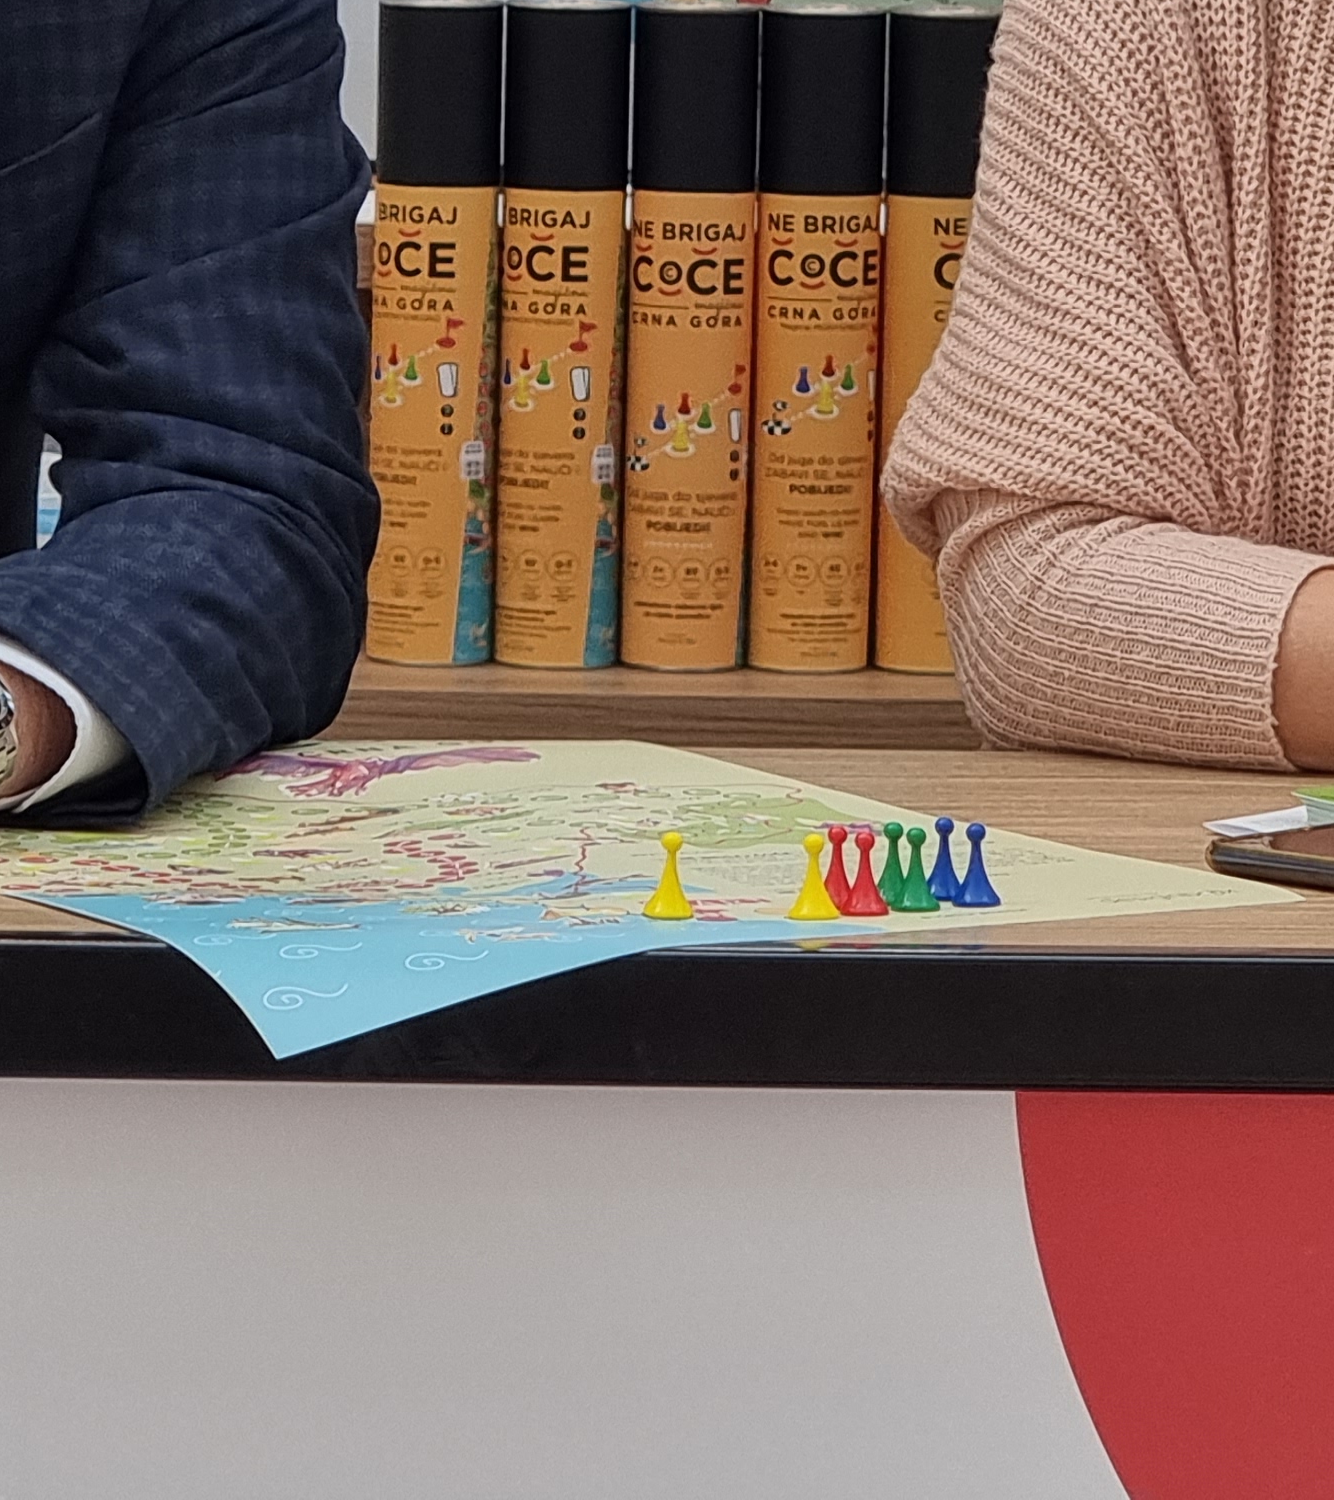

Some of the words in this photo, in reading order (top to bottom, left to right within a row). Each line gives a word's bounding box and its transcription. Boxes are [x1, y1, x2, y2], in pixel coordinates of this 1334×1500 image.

[507, 206, 591, 230] BRIGAJ
[768, 213, 795, 232] NE
[803, 214, 879, 235] BRIGAJ
[933, 217, 968, 237] NE
[662, 222, 747, 243] BRIGAJ
[396, 298, 455, 312] GORA
[528, 301, 588, 316] GORA
[767, 305, 821, 321] CRNA
[689, 313, 743, 329] GORA
